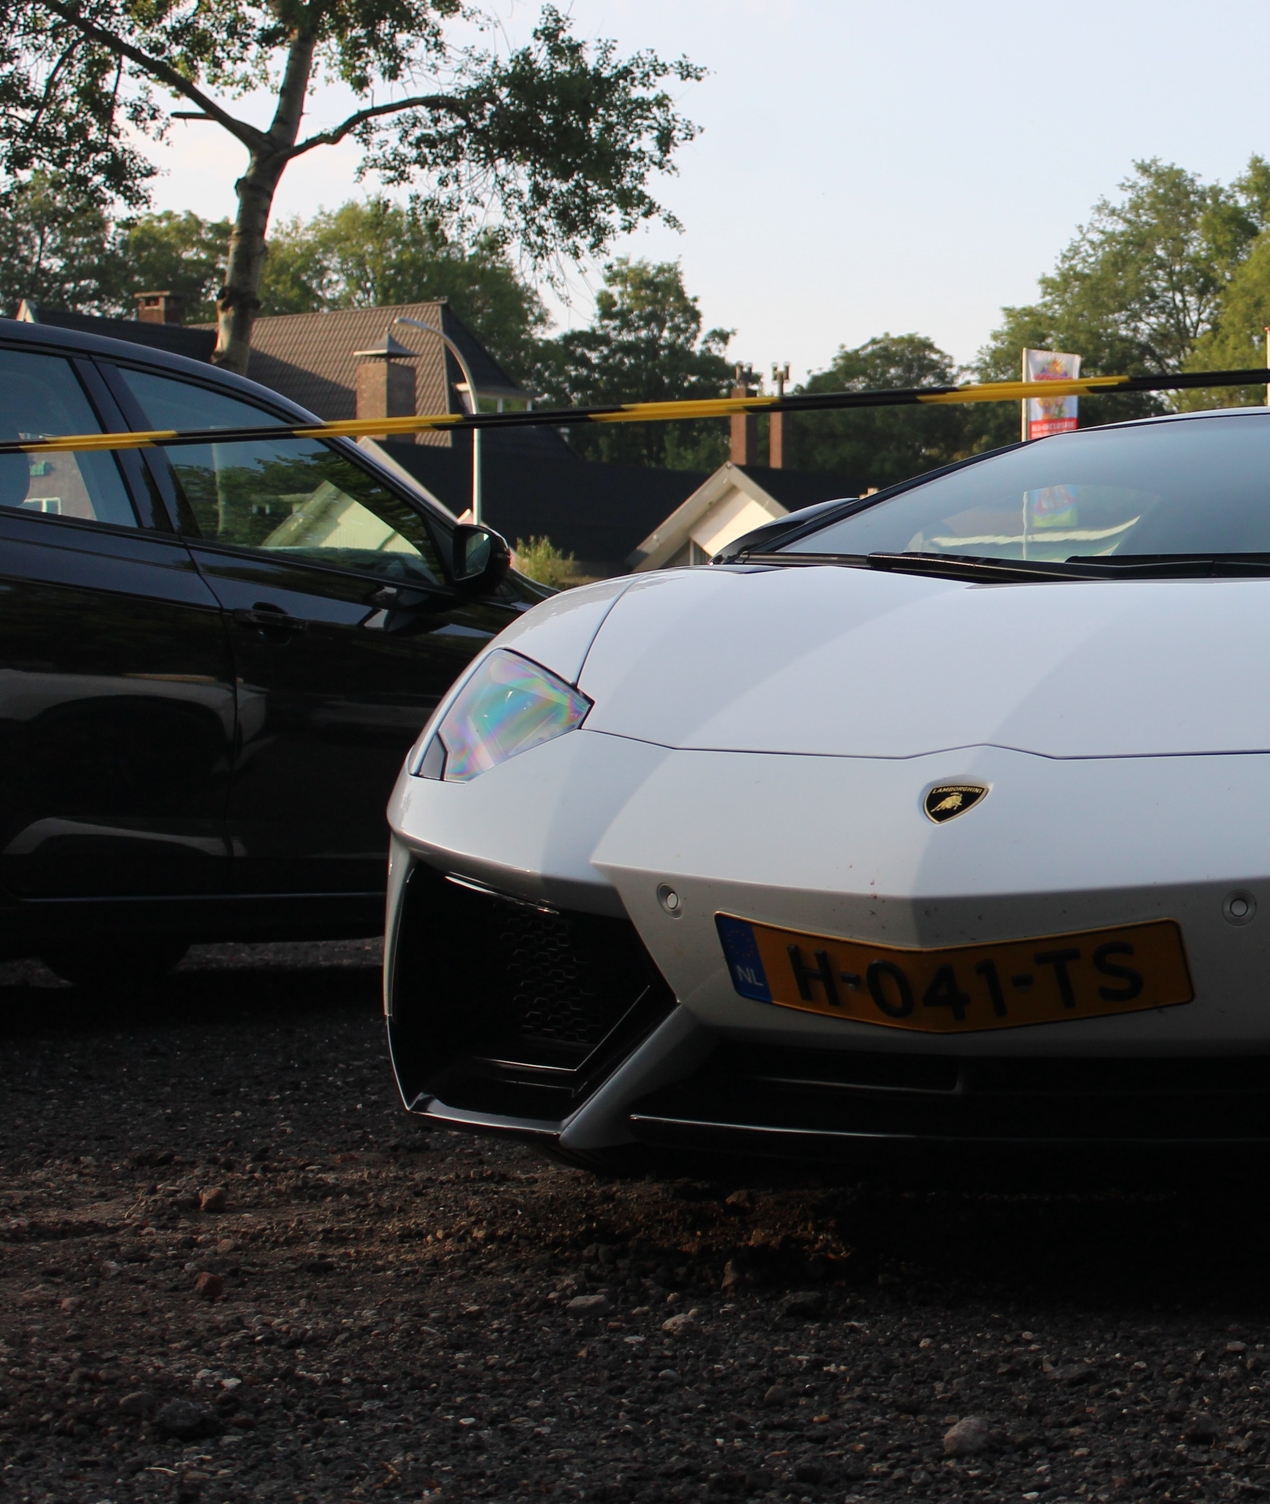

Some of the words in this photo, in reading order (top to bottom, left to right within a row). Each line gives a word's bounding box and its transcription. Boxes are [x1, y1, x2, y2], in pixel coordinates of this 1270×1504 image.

[932, 786, 983, 794] LAMBORGHINI
[736, 964, 764, 988] NL
[786, 941, 1144, 1021] H-041-TS
